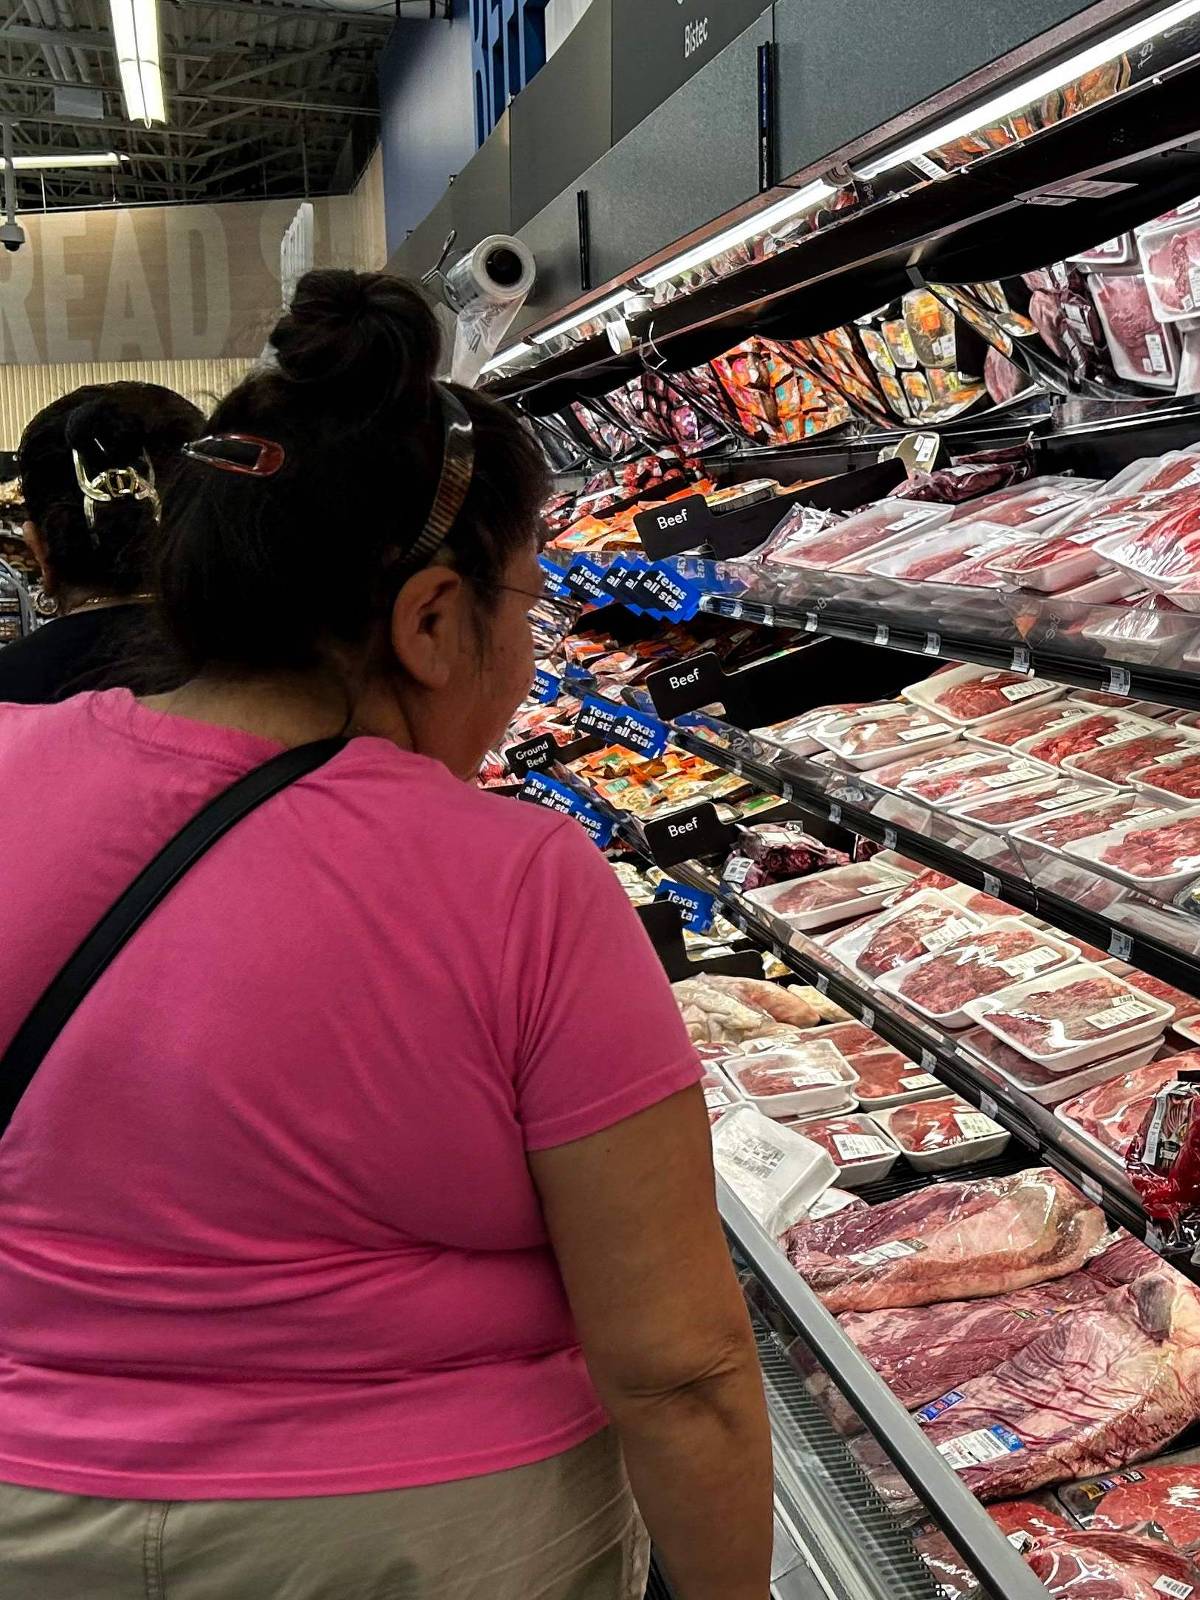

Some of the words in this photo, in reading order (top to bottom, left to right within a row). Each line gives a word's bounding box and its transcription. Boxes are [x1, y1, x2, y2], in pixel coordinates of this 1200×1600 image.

[684, 17, 708, 58] Bistec
[657, 509, 688, 530] Beef
[570, 573, 582, 586] all
[584, 580, 606, 598] star
[643, 578, 658, 594] all
[659, 591, 683, 612] star
[656, 570, 687, 600] Texas
[669, 668, 700, 689] Beef
[580, 716, 595, 727] all
[625, 715, 656, 738] Texas
[614, 725, 629, 738] all
[631, 732, 655, 750] star
[515, 741, 549, 761] Ground
[526, 754, 548, 768] Beef
[525, 786, 536, 795] all
[541, 796, 554, 807] all
[555, 800, 570, 815] sta
[575, 810, 602, 830] Texas
[667, 817, 698, 838] Beef
[667, 889, 698, 910] Texas
